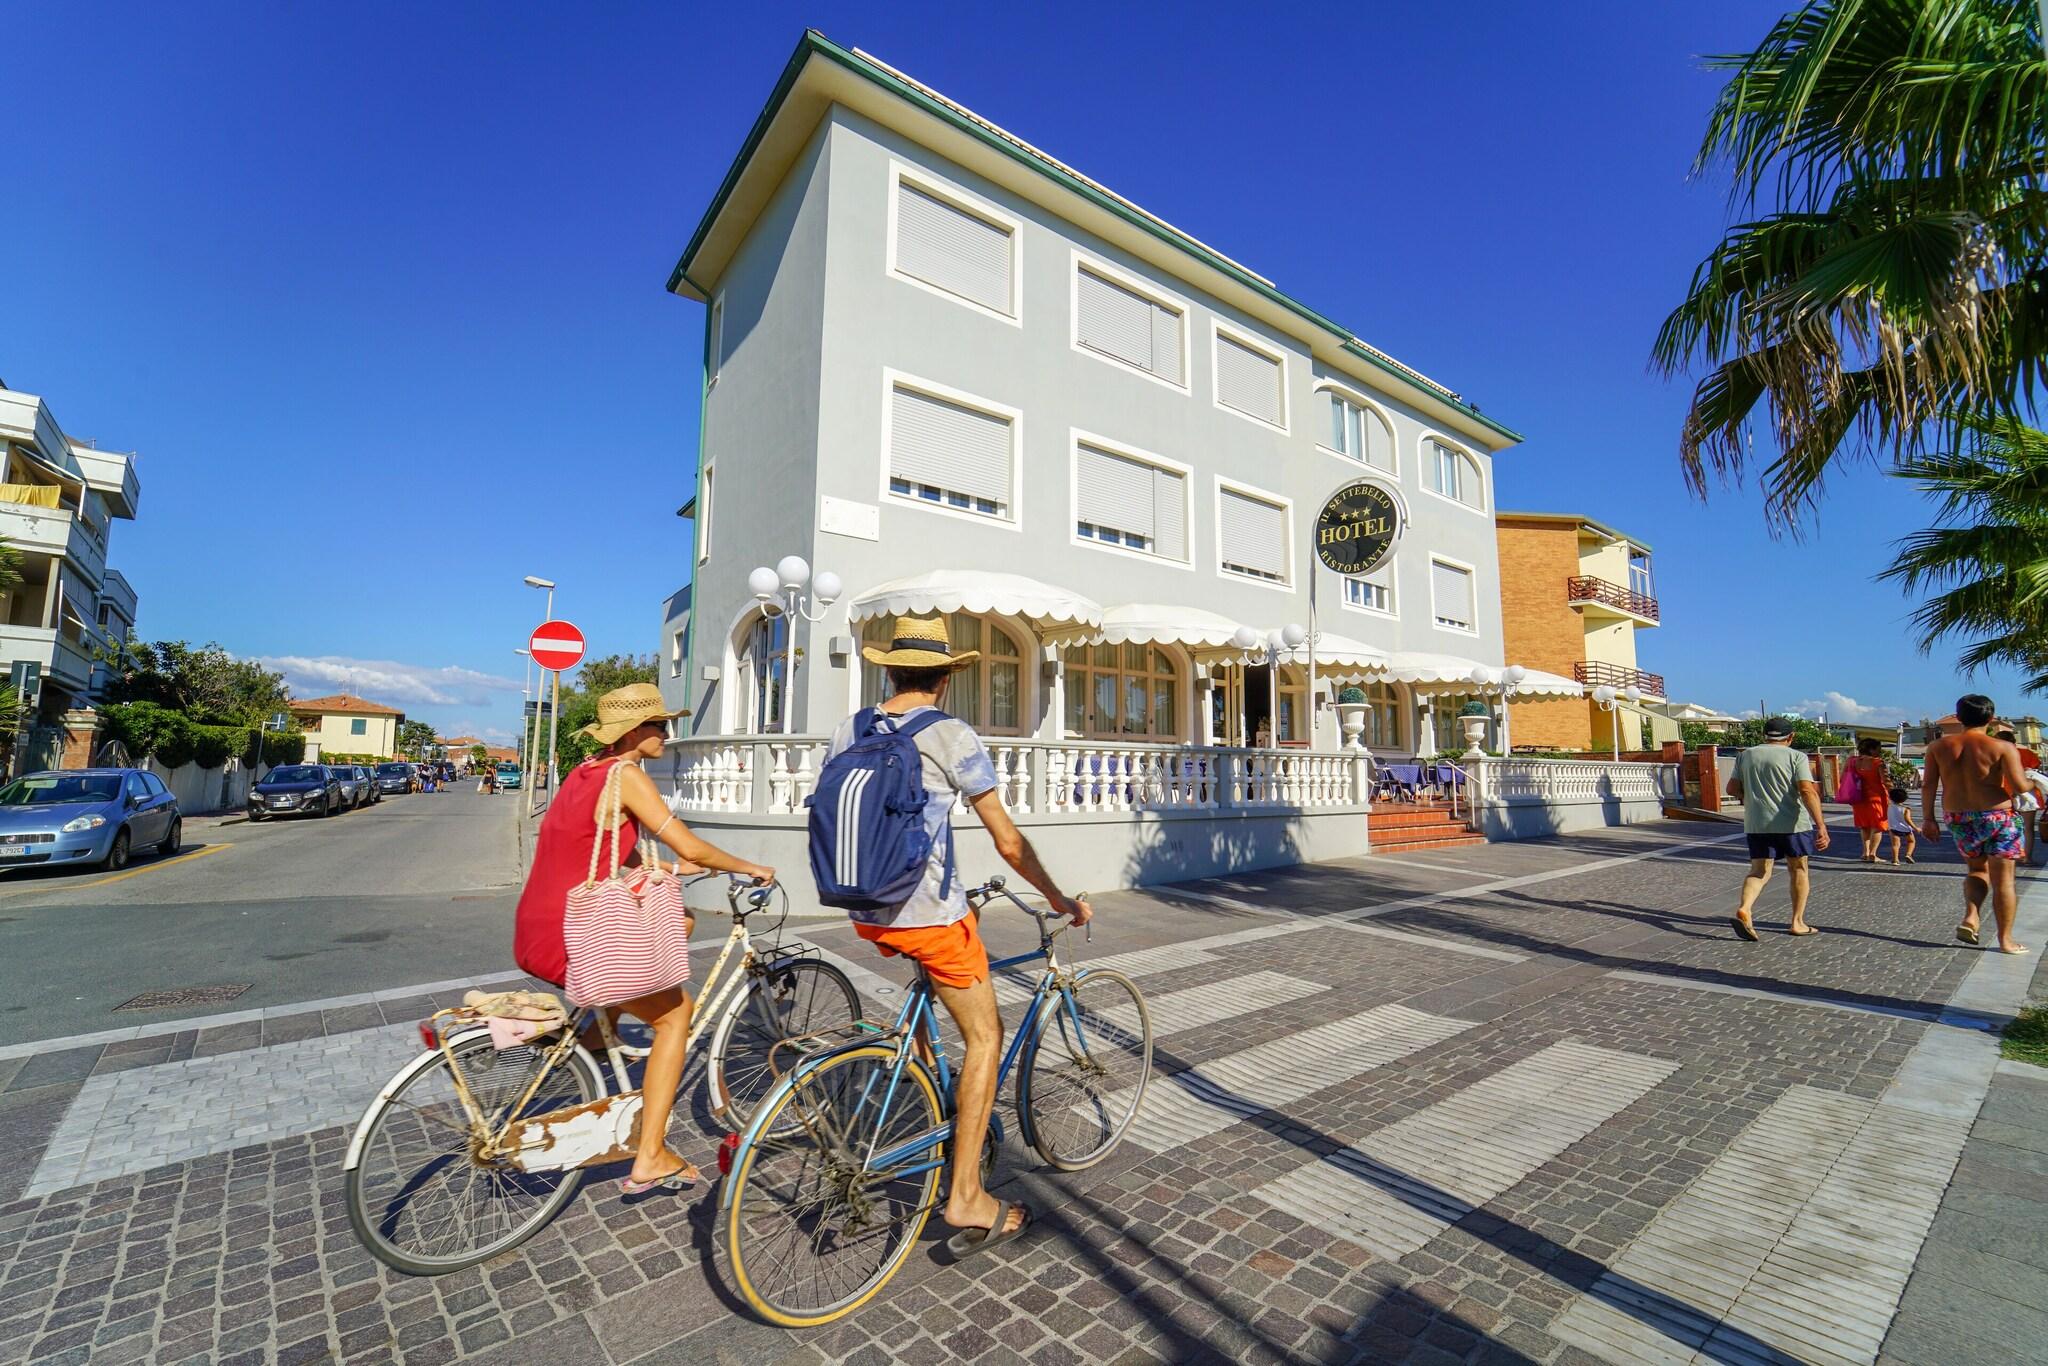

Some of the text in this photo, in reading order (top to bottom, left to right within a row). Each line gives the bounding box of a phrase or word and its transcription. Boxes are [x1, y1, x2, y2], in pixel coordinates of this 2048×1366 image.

[1320, 486, 1390, 522] IL SETTEBELLO
[1320, 516, 1390, 545] HOTEL
[1320, 538, 1390, 572] RISTORANTE
